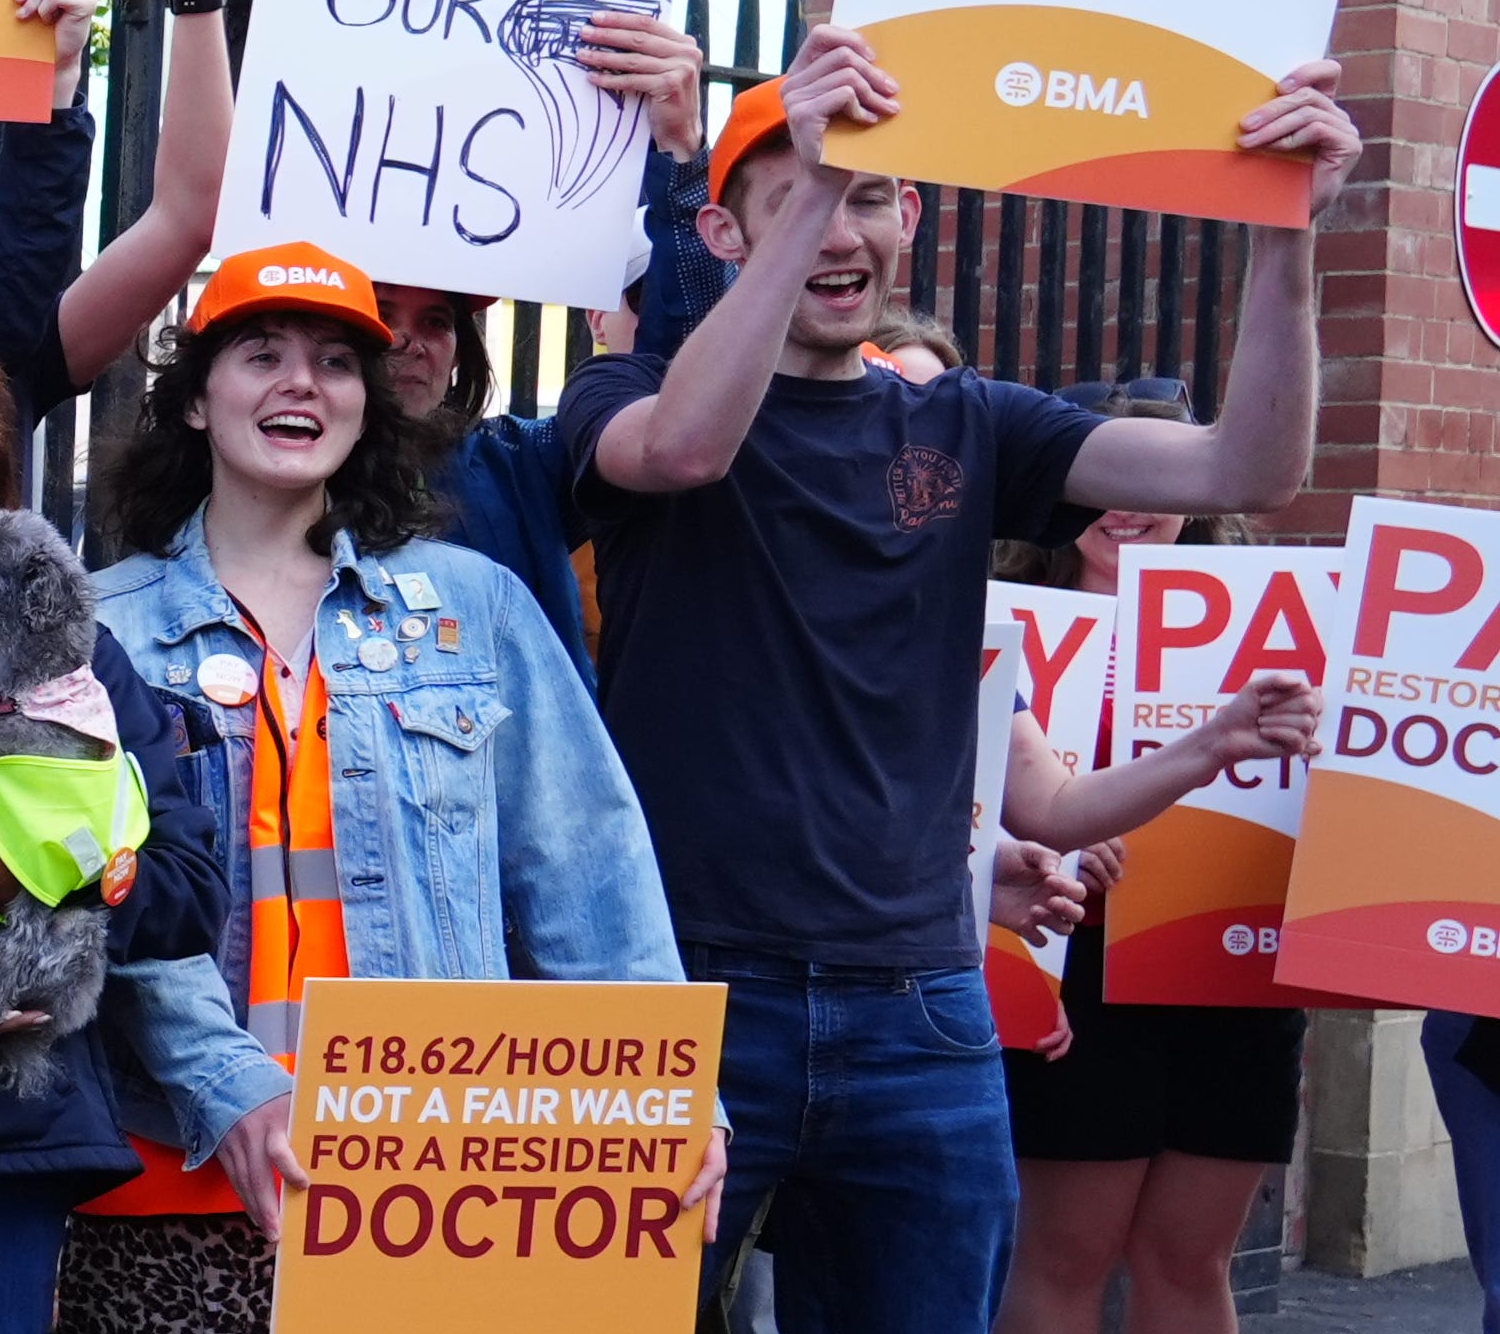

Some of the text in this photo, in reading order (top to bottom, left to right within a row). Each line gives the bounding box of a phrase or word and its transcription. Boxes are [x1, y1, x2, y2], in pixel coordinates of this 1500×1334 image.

[1045, 71, 1147, 118] BMA
[261, 80, 525, 246] NHS
[288, 266, 345, 291] BMA
[1135, 569, 1341, 693] PA
[1346, 667, 1500, 712] RESTOR
[323, 1033, 697, 1077] £18.62/HOUR IS
[316, 1086, 692, 1125] NOT A FAIR WAGE
[311, 1135, 687, 1172] FOR A RESIDENT
[304, 1184, 683, 1259] DOCTOR
